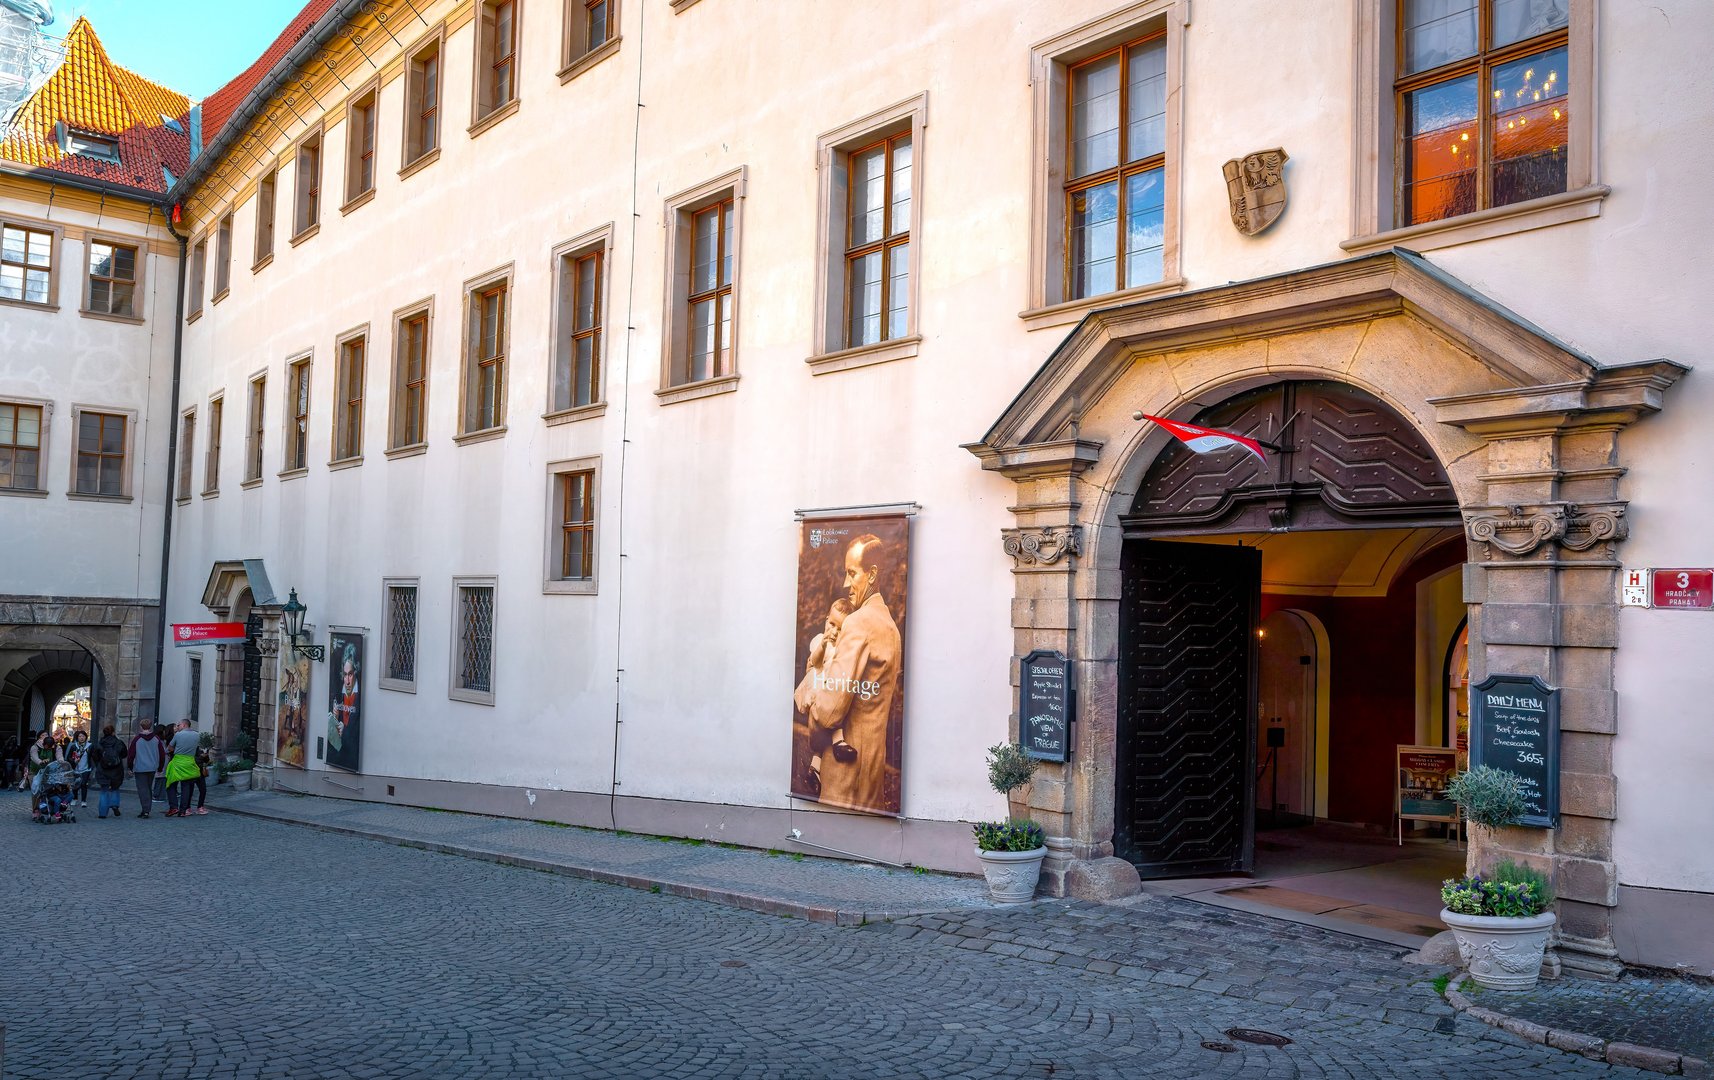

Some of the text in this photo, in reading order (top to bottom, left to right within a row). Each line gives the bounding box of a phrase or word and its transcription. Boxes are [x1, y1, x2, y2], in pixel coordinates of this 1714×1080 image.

[1630, 574, 1640, 586] H
[1676, 572, 1690, 589] 3
[1665, 589, 1700, 597] HRADČY
[813, 670, 880, 701] Heritage
[1487, 694, 1543, 710] DAILY MENU
[1494, 710, 1508, 721] Soup
[1495, 723, 1511, 734] Beef
[1033, 736, 1060, 750] PRAGUE
[1492, 737, 1535, 749] Cheesecake
